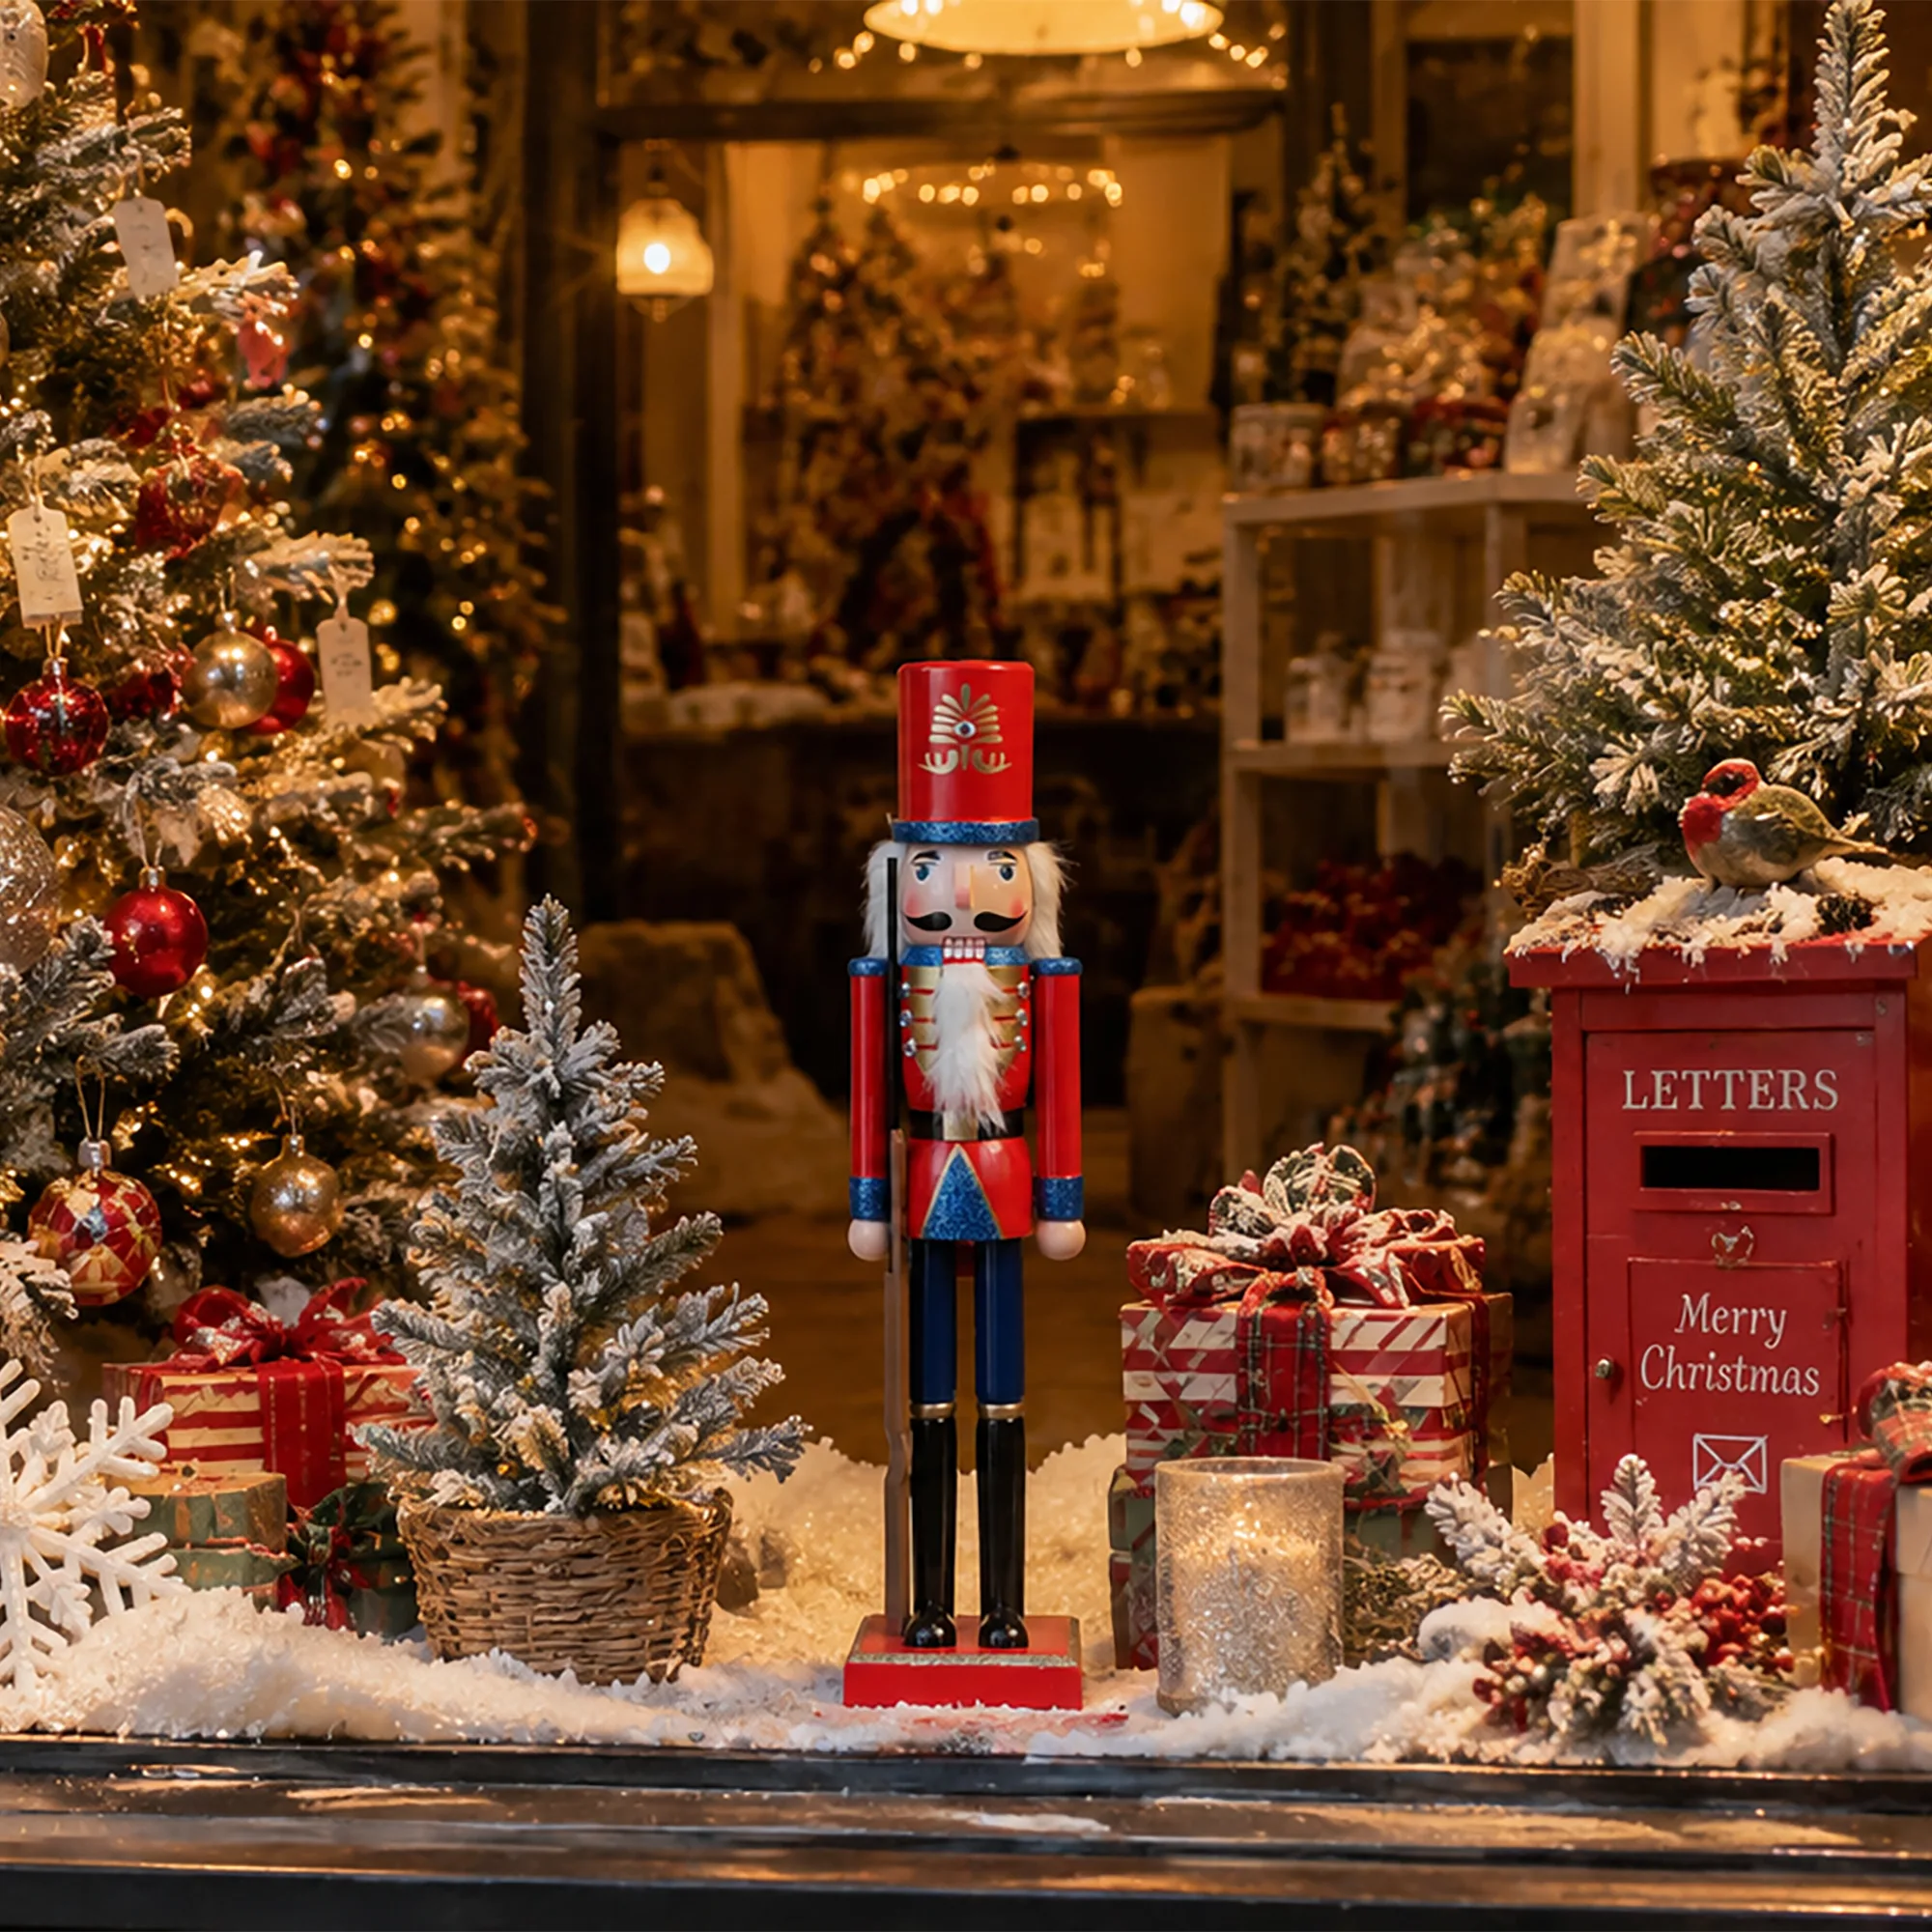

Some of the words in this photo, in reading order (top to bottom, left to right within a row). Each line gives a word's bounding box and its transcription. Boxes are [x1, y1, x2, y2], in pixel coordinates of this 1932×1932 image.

[1622, 1068, 1839, 1111] LETTERS
[1673, 1292, 1787, 1350] Merry
[1640, 1344, 1820, 1397] Christmas
